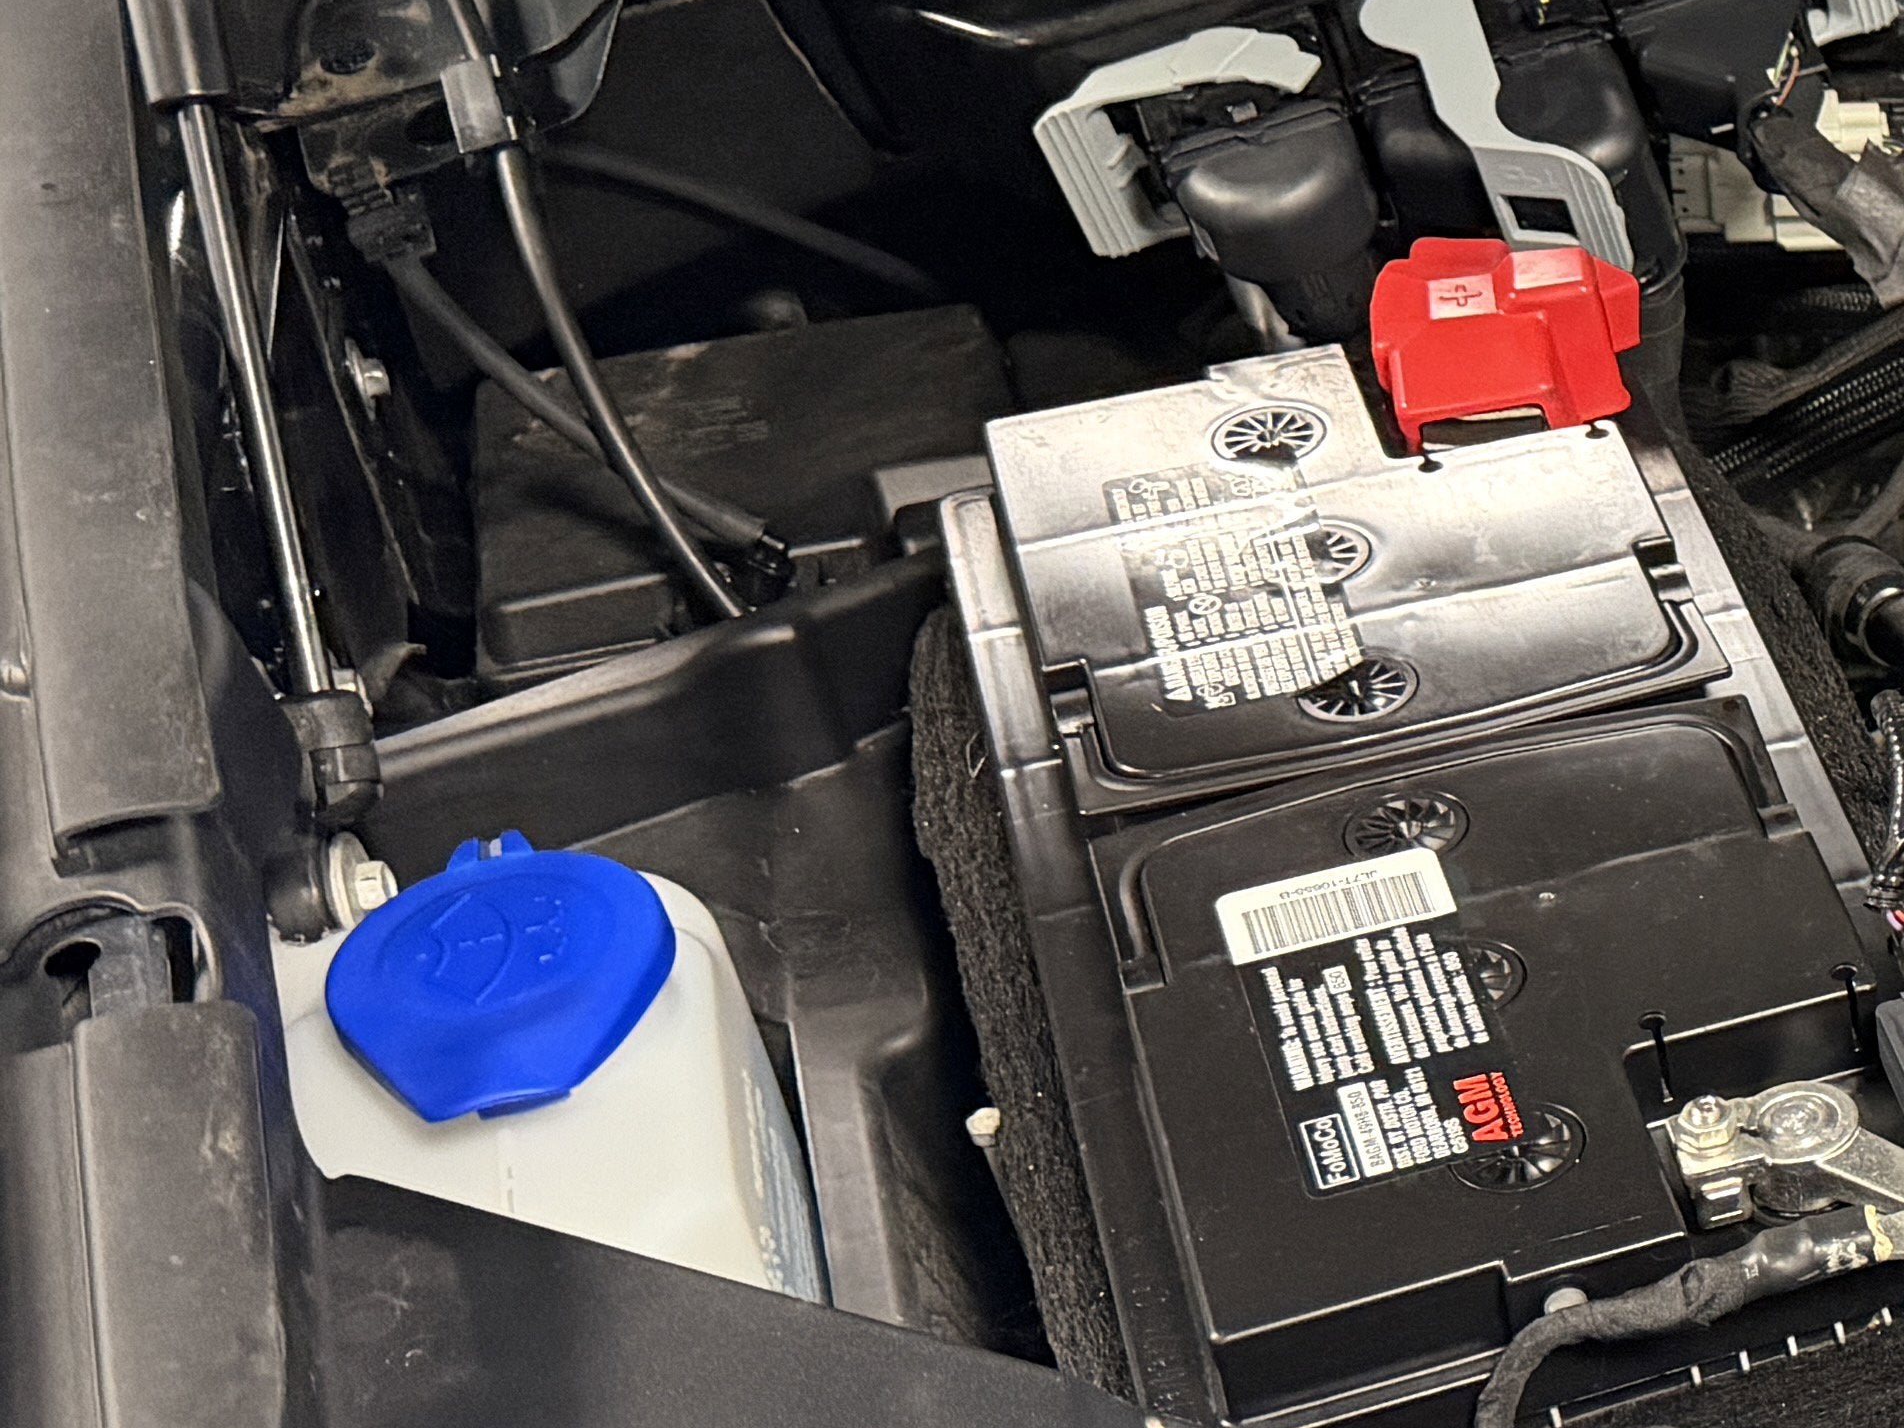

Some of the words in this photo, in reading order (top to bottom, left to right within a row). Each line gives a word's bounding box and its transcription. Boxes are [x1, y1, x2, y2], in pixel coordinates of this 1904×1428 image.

[1453, 1074, 1508, 1140] AGM
[1490, 1072, 1523, 1137] TECHNOLOGY
[1314, 1116, 1350, 1184] FoMoCo
